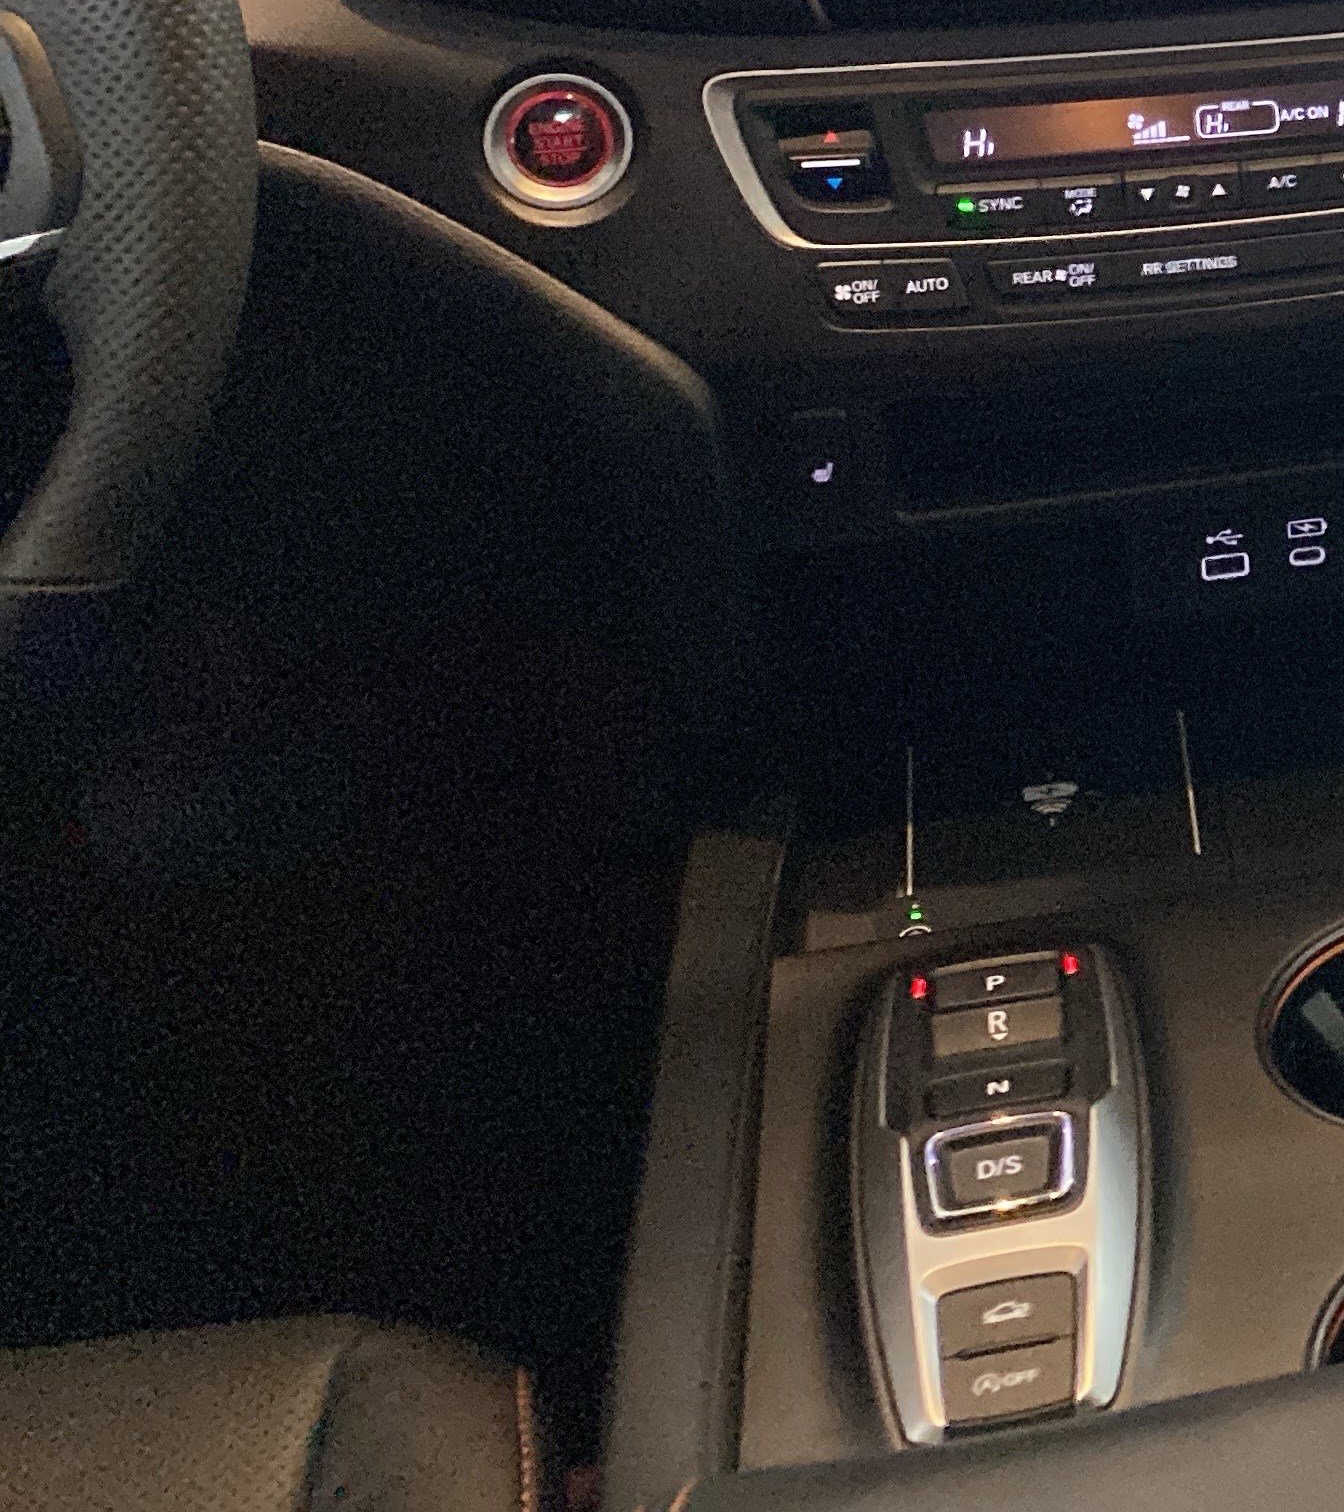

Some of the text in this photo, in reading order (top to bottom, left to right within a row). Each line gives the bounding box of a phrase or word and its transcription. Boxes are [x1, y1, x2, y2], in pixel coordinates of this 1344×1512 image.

[1280, 104, 1330, 122] A/C ON
[1267, 173, 1298, 190] A/C
[978, 195, 1024, 213] SYNC
[1142, 254, 1239, 277] RR SETTINGS
[905, 277, 949, 294] AUTO
[1012, 269, 1053, 286] REAR
[1068, 274, 1097, 288] OFF
[853, 291, 881, 304] OFF
[985, 975, 1005, 991] P
[988, 1010, 1008, 1033] R
[986, 1080, 1010, 1095] N
[975, 1155, 1024, 1182] D/S
